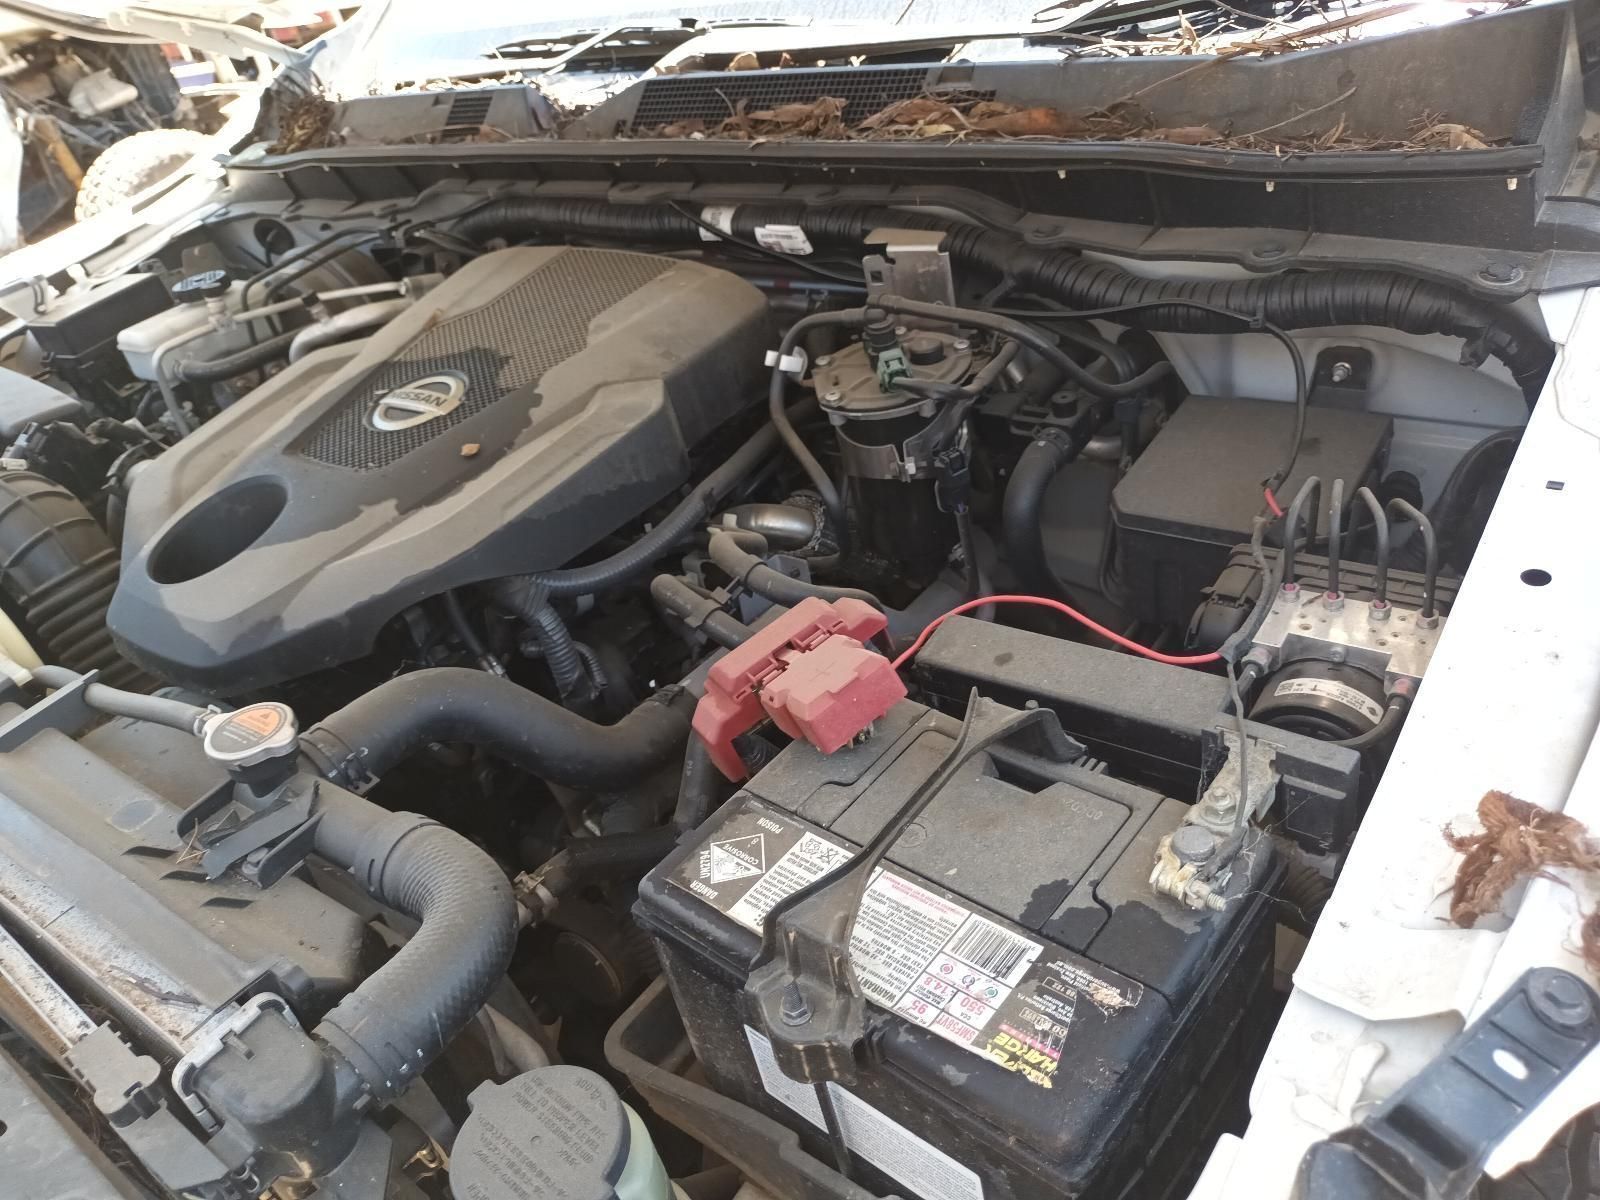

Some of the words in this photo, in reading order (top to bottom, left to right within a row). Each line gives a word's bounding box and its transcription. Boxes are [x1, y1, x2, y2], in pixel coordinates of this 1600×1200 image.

[390, 392, 448, 407] NISSAN
[756, 817, 783, 833] POISON
[722, 844, 759, 864] CORROSIVE
[701, 849, 709, 878] UN2794
[688, 880, 718, 898] DANGER
[874, 947, 885, 955] USE
[881, 959, 892, 967] USE
[885, 954, 918, 973] COMMERCIAL
[892, 965, 915, 979] PRIVATE
[923, 976, 948, 994] 14.8
[909, 999, 928, 1014] 95
[959, 996, 985, 1016] 550
[959, 1011, 971, 1021] CCA
[935, 1013, 975, 1041] SMF58VT
[993, 1030, 1057, 1072] HARGE
